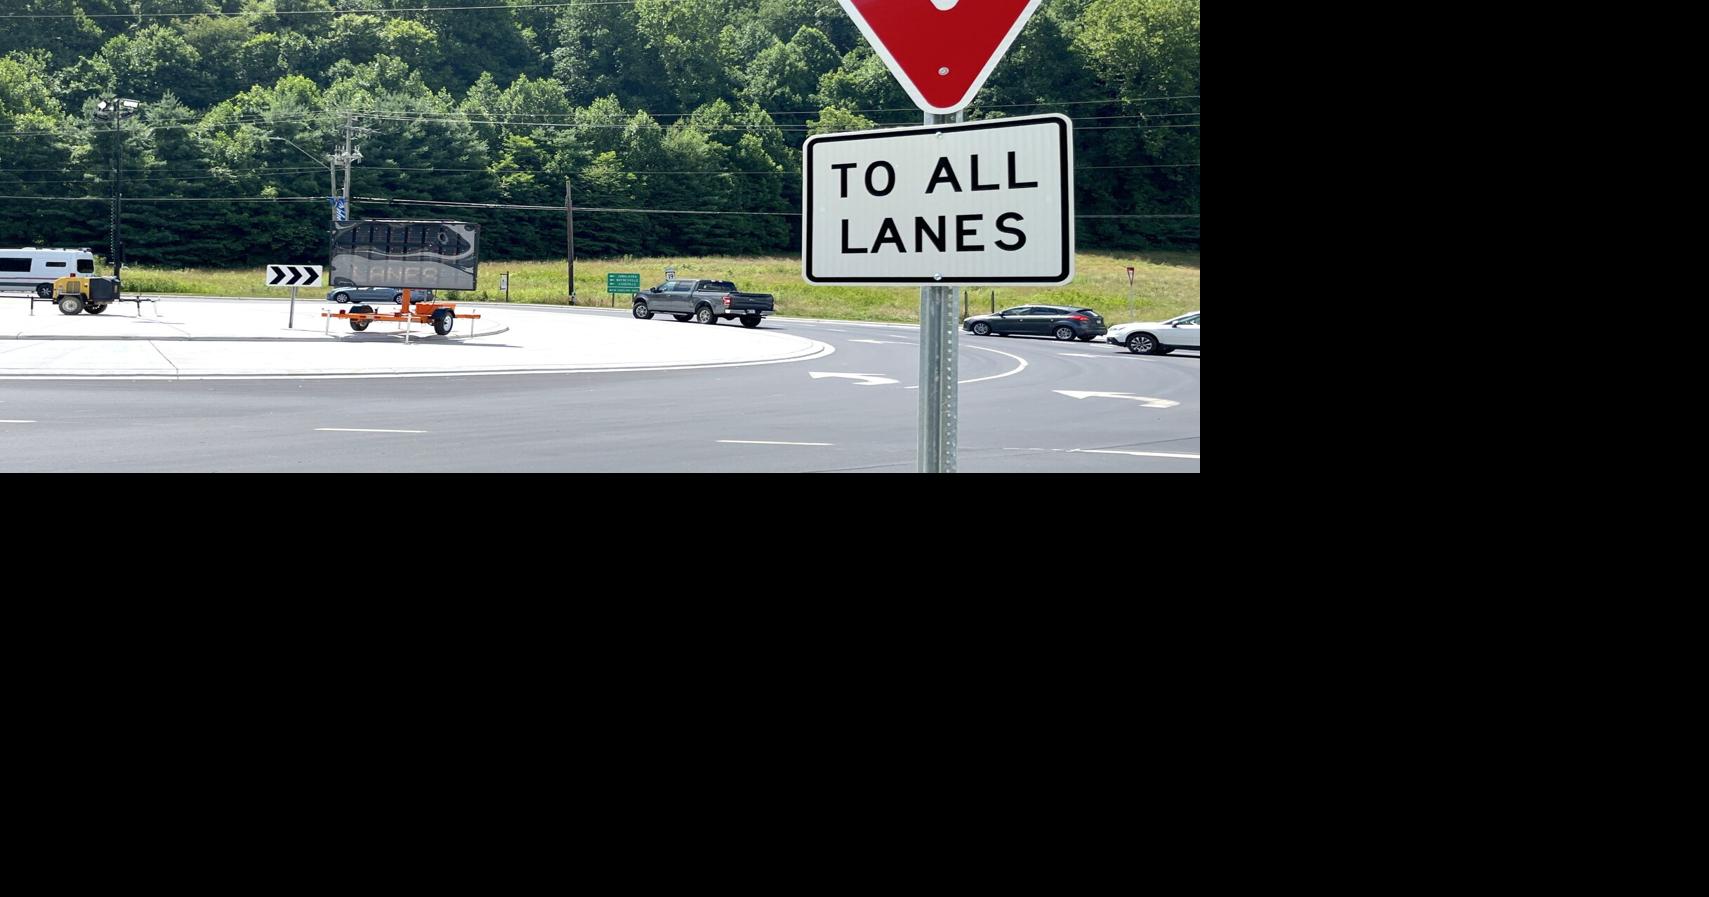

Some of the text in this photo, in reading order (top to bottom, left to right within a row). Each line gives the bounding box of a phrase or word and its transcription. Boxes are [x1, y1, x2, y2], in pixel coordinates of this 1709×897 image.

[832, 151, 1038, 198] TO ALL
[841, 212, 1026, 254] LANES
